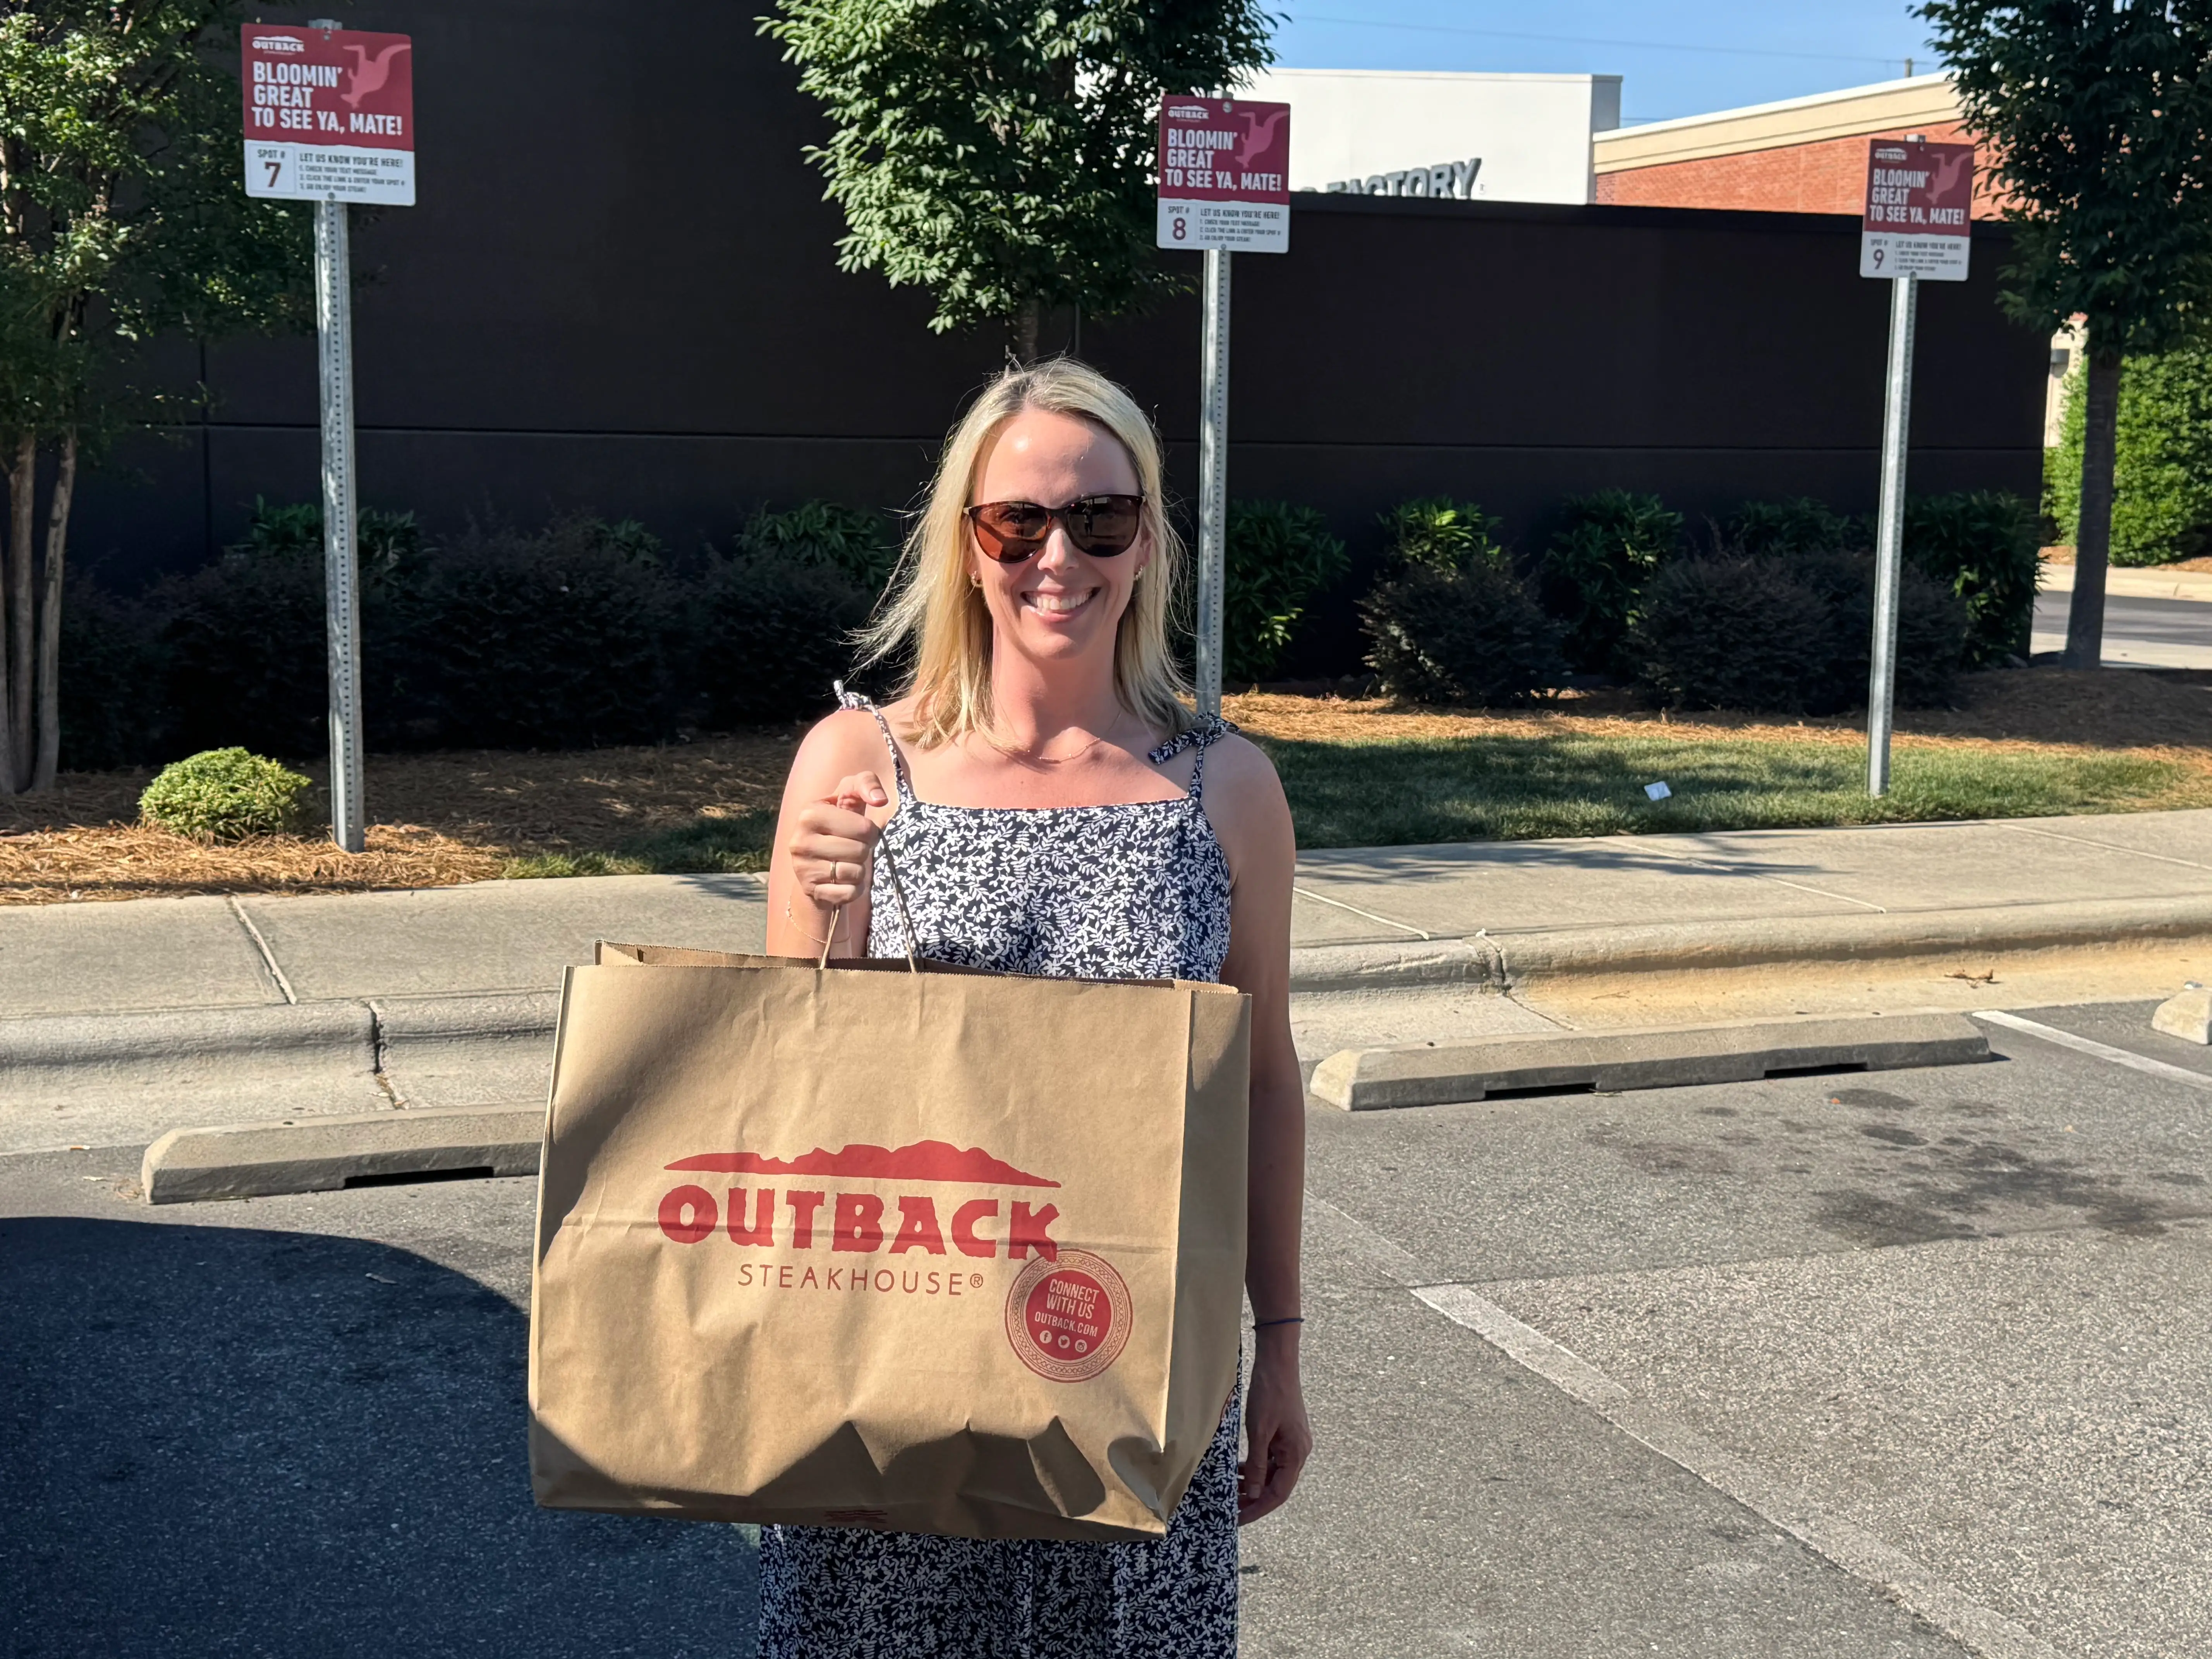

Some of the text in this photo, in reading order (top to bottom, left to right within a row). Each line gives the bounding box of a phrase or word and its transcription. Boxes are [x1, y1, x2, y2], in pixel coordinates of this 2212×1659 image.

[252, 40, 304, 52] OUTBACK
[253, 61, 343, 88] BLOOMIN'
[254, 84, 314, 108] GREAT
[251, 107, 402, 136] TO SEE YA, MATE!
[1168, 110, 1209, 119] OUTBACK
[1168, 128, 1238, 150] BLOOMIN'
[257, 149, 278, 158] SPOT
[1167, 148, 1214, 168] GREAT
[264, 161, 281, 187] 7
[1165, 169, 1281, 191] TO SEE YA, MATE!
[1874, 168, 1930, 188] BLOOMIN'
[1872, 186, 1910, 204] GREAT
[1870, 204, 1965, 225] TO SEE YA, MATE!
[1172, 217, 1186, 240] 8
[1873, 249, 1884, 269] 9
[658, 1185, 1060, 1263] OUTBACK
[1049, 1279, 1099, 1303] CONNECT
[1047, 1293, 1094, 1319] WITH US
[1034, 1311, 1098, 1337] OUTBACK.COM
